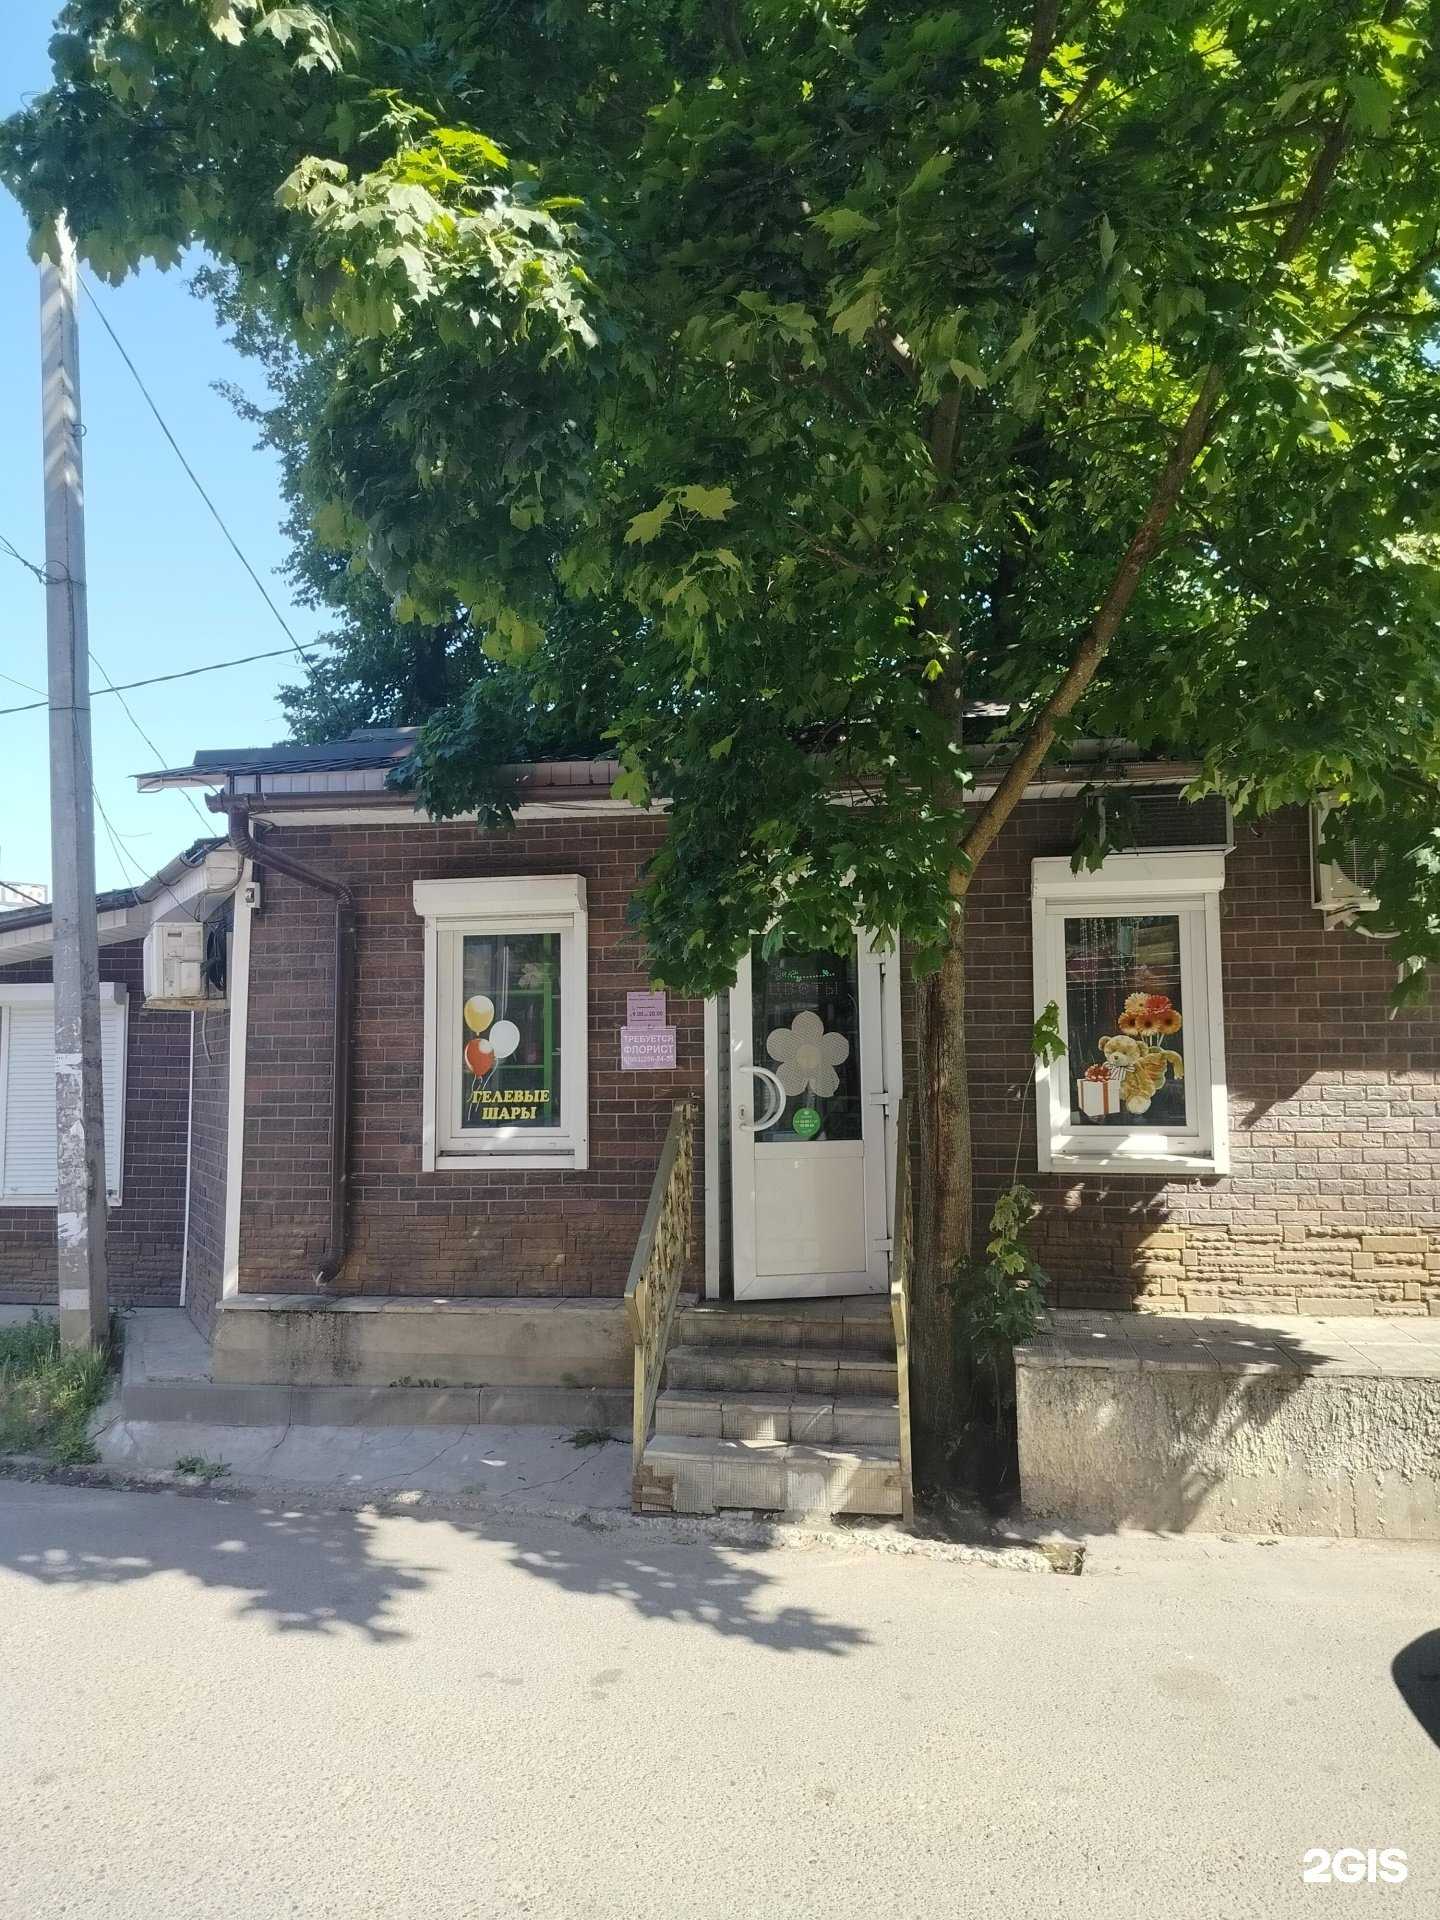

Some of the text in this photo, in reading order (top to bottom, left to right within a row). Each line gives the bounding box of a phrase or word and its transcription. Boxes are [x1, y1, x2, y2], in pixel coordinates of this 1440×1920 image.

[623, 1034, 674, 1043] ТРЕБУЕТСЯ
[623, 1044, 674, 1054] ФЛОРИСТ
[472, 1089, 550, 1103] ГЕЛЕВЫЕ
[482, 1106, 537, 1120] ШАРЫ
